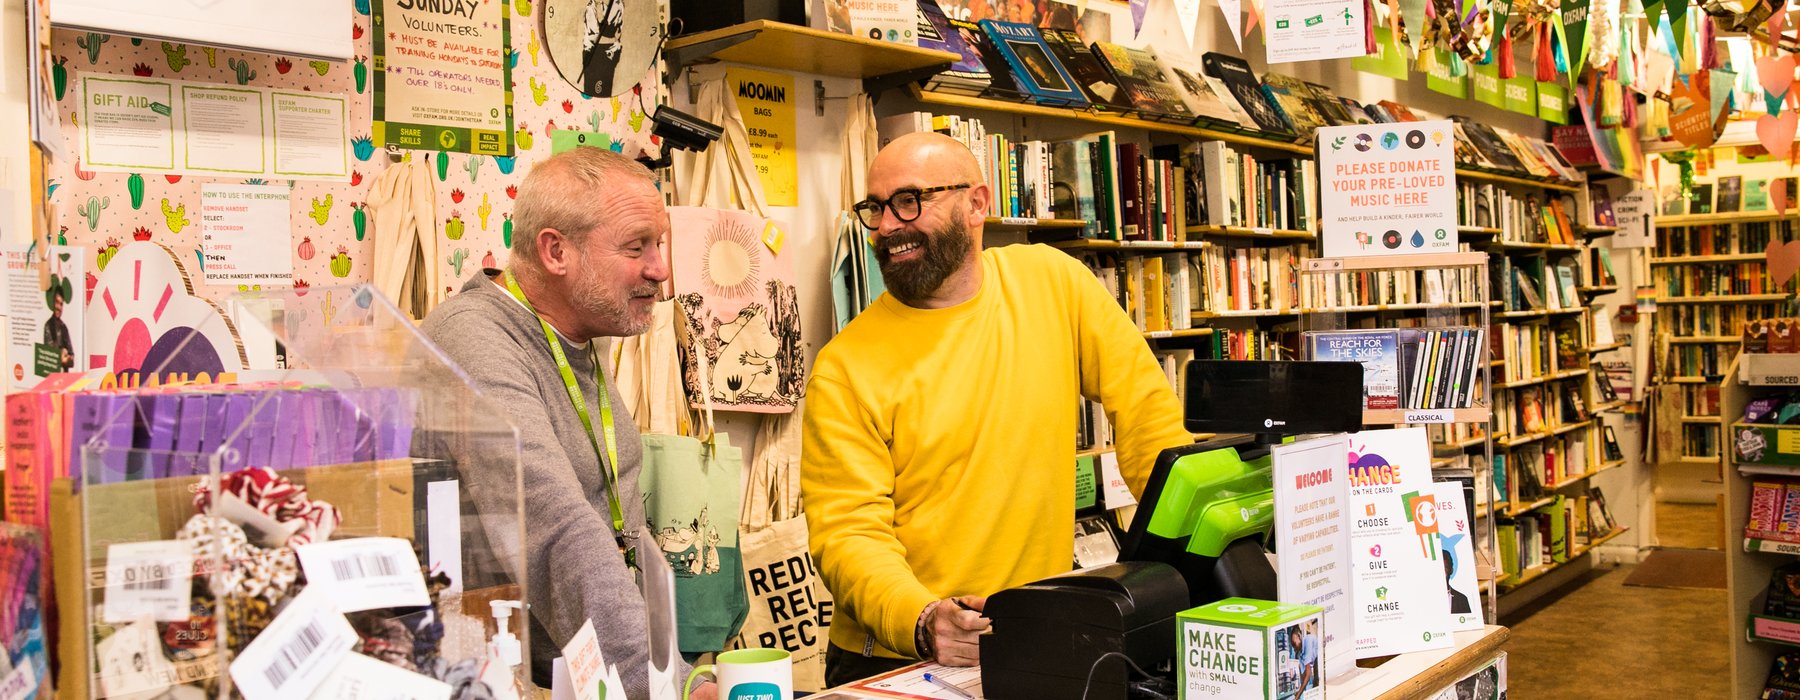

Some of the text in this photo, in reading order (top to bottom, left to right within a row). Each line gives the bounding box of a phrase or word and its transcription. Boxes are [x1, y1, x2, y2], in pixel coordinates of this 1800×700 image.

[548, 5, 554, 18] 9
[849, 2, 898, 12] MUSIC HERE
[1563, 7, 1586, 26] OXFAM
[402, 14, 482, 37] VOLUNTEERS.
[650, 27, 657, 37] 3
[990, 21, 1035, 36] MOZART
[401, 34, 499, 57] MUST BE AVAILABLE FOR
[396, 47, 435, 60] TRAINING
[406, 67, 424, 76] TILL
[429, 70, 472, 82] OPERATORS
[406, 78, 429, 87] OVER
[450, 85, 475, 95] ONLY.
[1476, 72, 1497, 93] POLITICS
[190, 92, 248, 103] SHOP REFUND POLICY
[739, 80, 785, 103] MOOMIN
[1505, 83, 1528, 102] SCIENCE
[93, 93, 148, 108] GIFT AID
[279, 105, 308, 113] SUPPORTER
[754, 107, 772, 117] BAGS
[400, 128, 421, 137] SHARE
[748, 128, 767, 137] £8.99
[1684, 120, 1709, 136] TITLES
[400, 137, 421, 145] SKILLS
[1336, 159, 1440, 176] PLEASE DONATE
[1009, 153, 1018, 199] CLEESE
[1332, 175, 1445, 192] YOUR PRE-LOVED
[1351, 192, 1429, 207] MUSIC HERE
[1330, 339, 1382, 348] REACH FOR
[1331, 347, 1383, 358] THE SKIES
[1764, 375, 1799, 384] SOURCED
[1295, 468, 1333, 490] WELCOME
[1374, 486, 1394, 494] CARDS
[1295, 501, 1309, 513] PLEASE
[1309, 499, 1319, 510] NOTE
[1319, 498, 1328, 507] THAT
[1291, 516, 1315, 530] VOLUNTEERS
[1315, 513, 1325, 523] HAVE
[1328, 509, 1340, 520] RANGE
[1357, 517, 1389, 528] CHOOSE
[1292, 536, 1299, 545] OF
[1299, 532, 1315, 543] VARYING
[1369, 560, 1388, 570] GIVE
[1367, 602, 1400, 613] CHANGE
[759, 616, 818, 653] REC
[1189, 630, 1236, 652] MAKE
[1189, 649, 1259, 676] CHANGE
[1189, 671, 1238, 685] with SMALL
[1189, 682, 1222, 695] change
